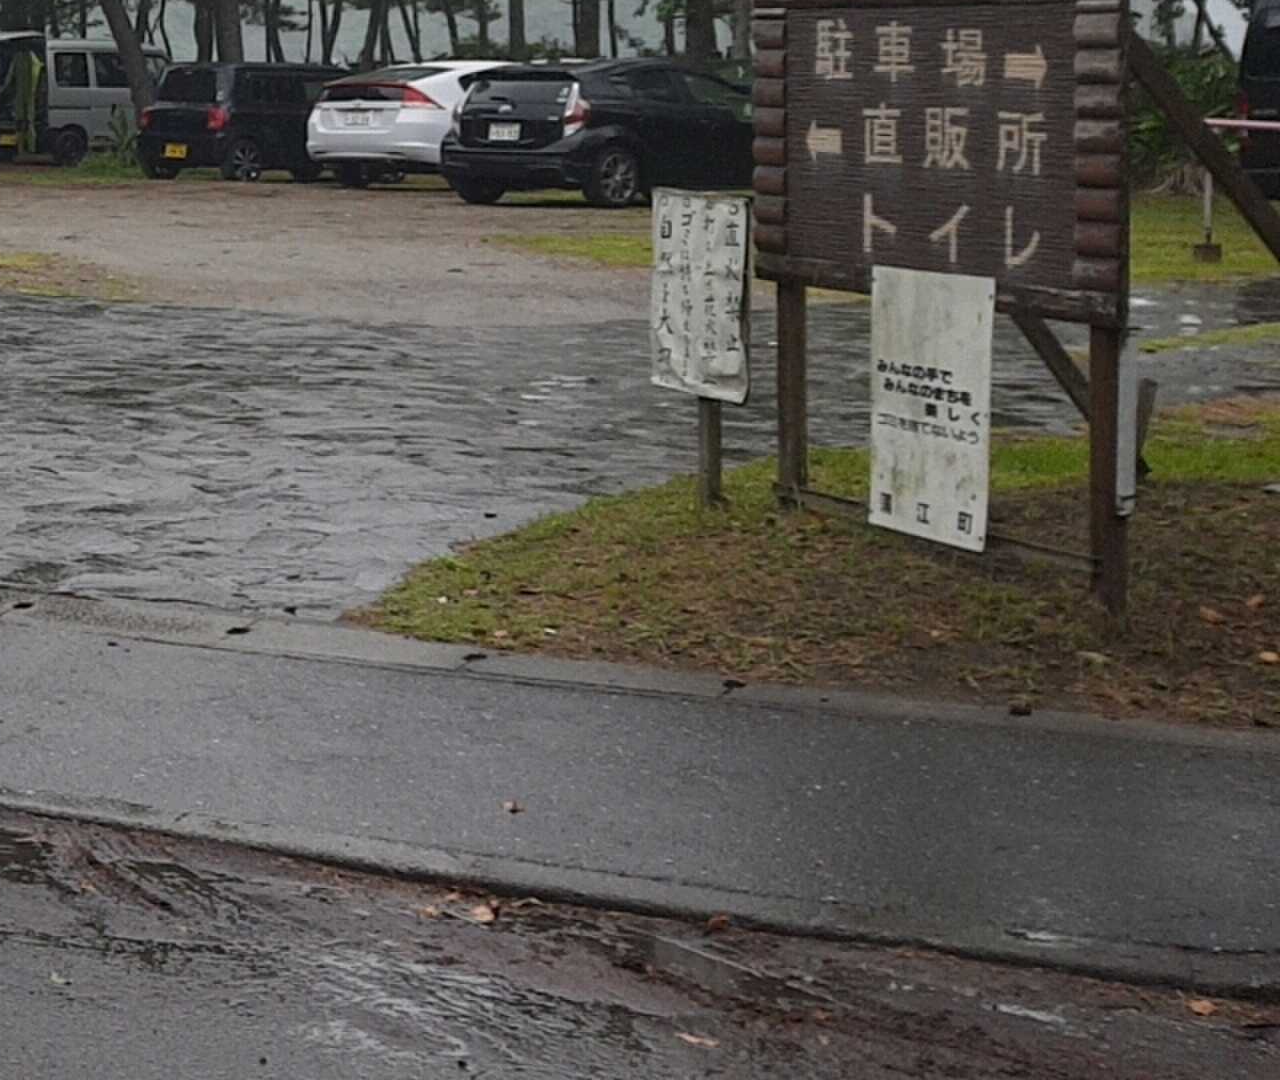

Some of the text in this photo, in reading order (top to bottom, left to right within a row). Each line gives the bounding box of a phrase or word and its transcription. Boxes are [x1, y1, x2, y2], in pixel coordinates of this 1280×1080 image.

[815, 18, 988, 88] 駐車場
[861, 102, 1048, 176] 直販所
[862, 193, 1041, 268] トイレ
